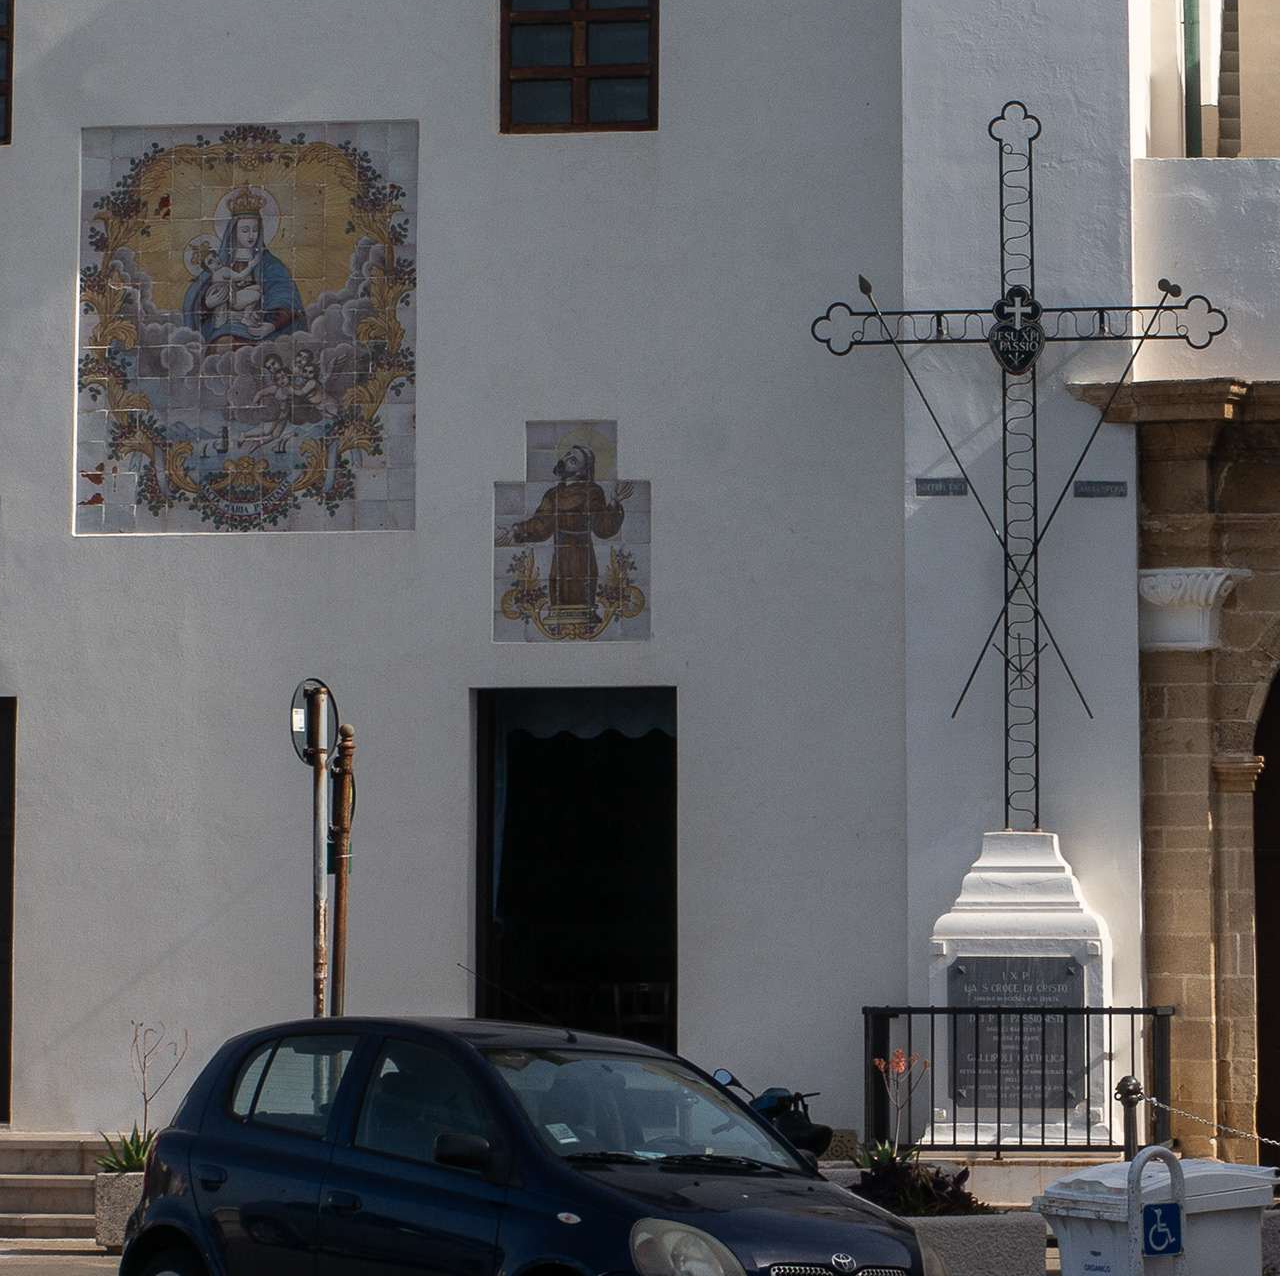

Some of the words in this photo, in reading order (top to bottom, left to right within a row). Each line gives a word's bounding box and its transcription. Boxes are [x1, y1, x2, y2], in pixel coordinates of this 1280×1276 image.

[993, 331, 1018, 341] JESU
[1000, 341, 1038, 352] PASSIO
[1036, 984, 1068, 993] CRISTO
[967, 1054, 1013, 1062] GLLIPLI
[1017, 1054, 1065, 1063] ATTLICA
